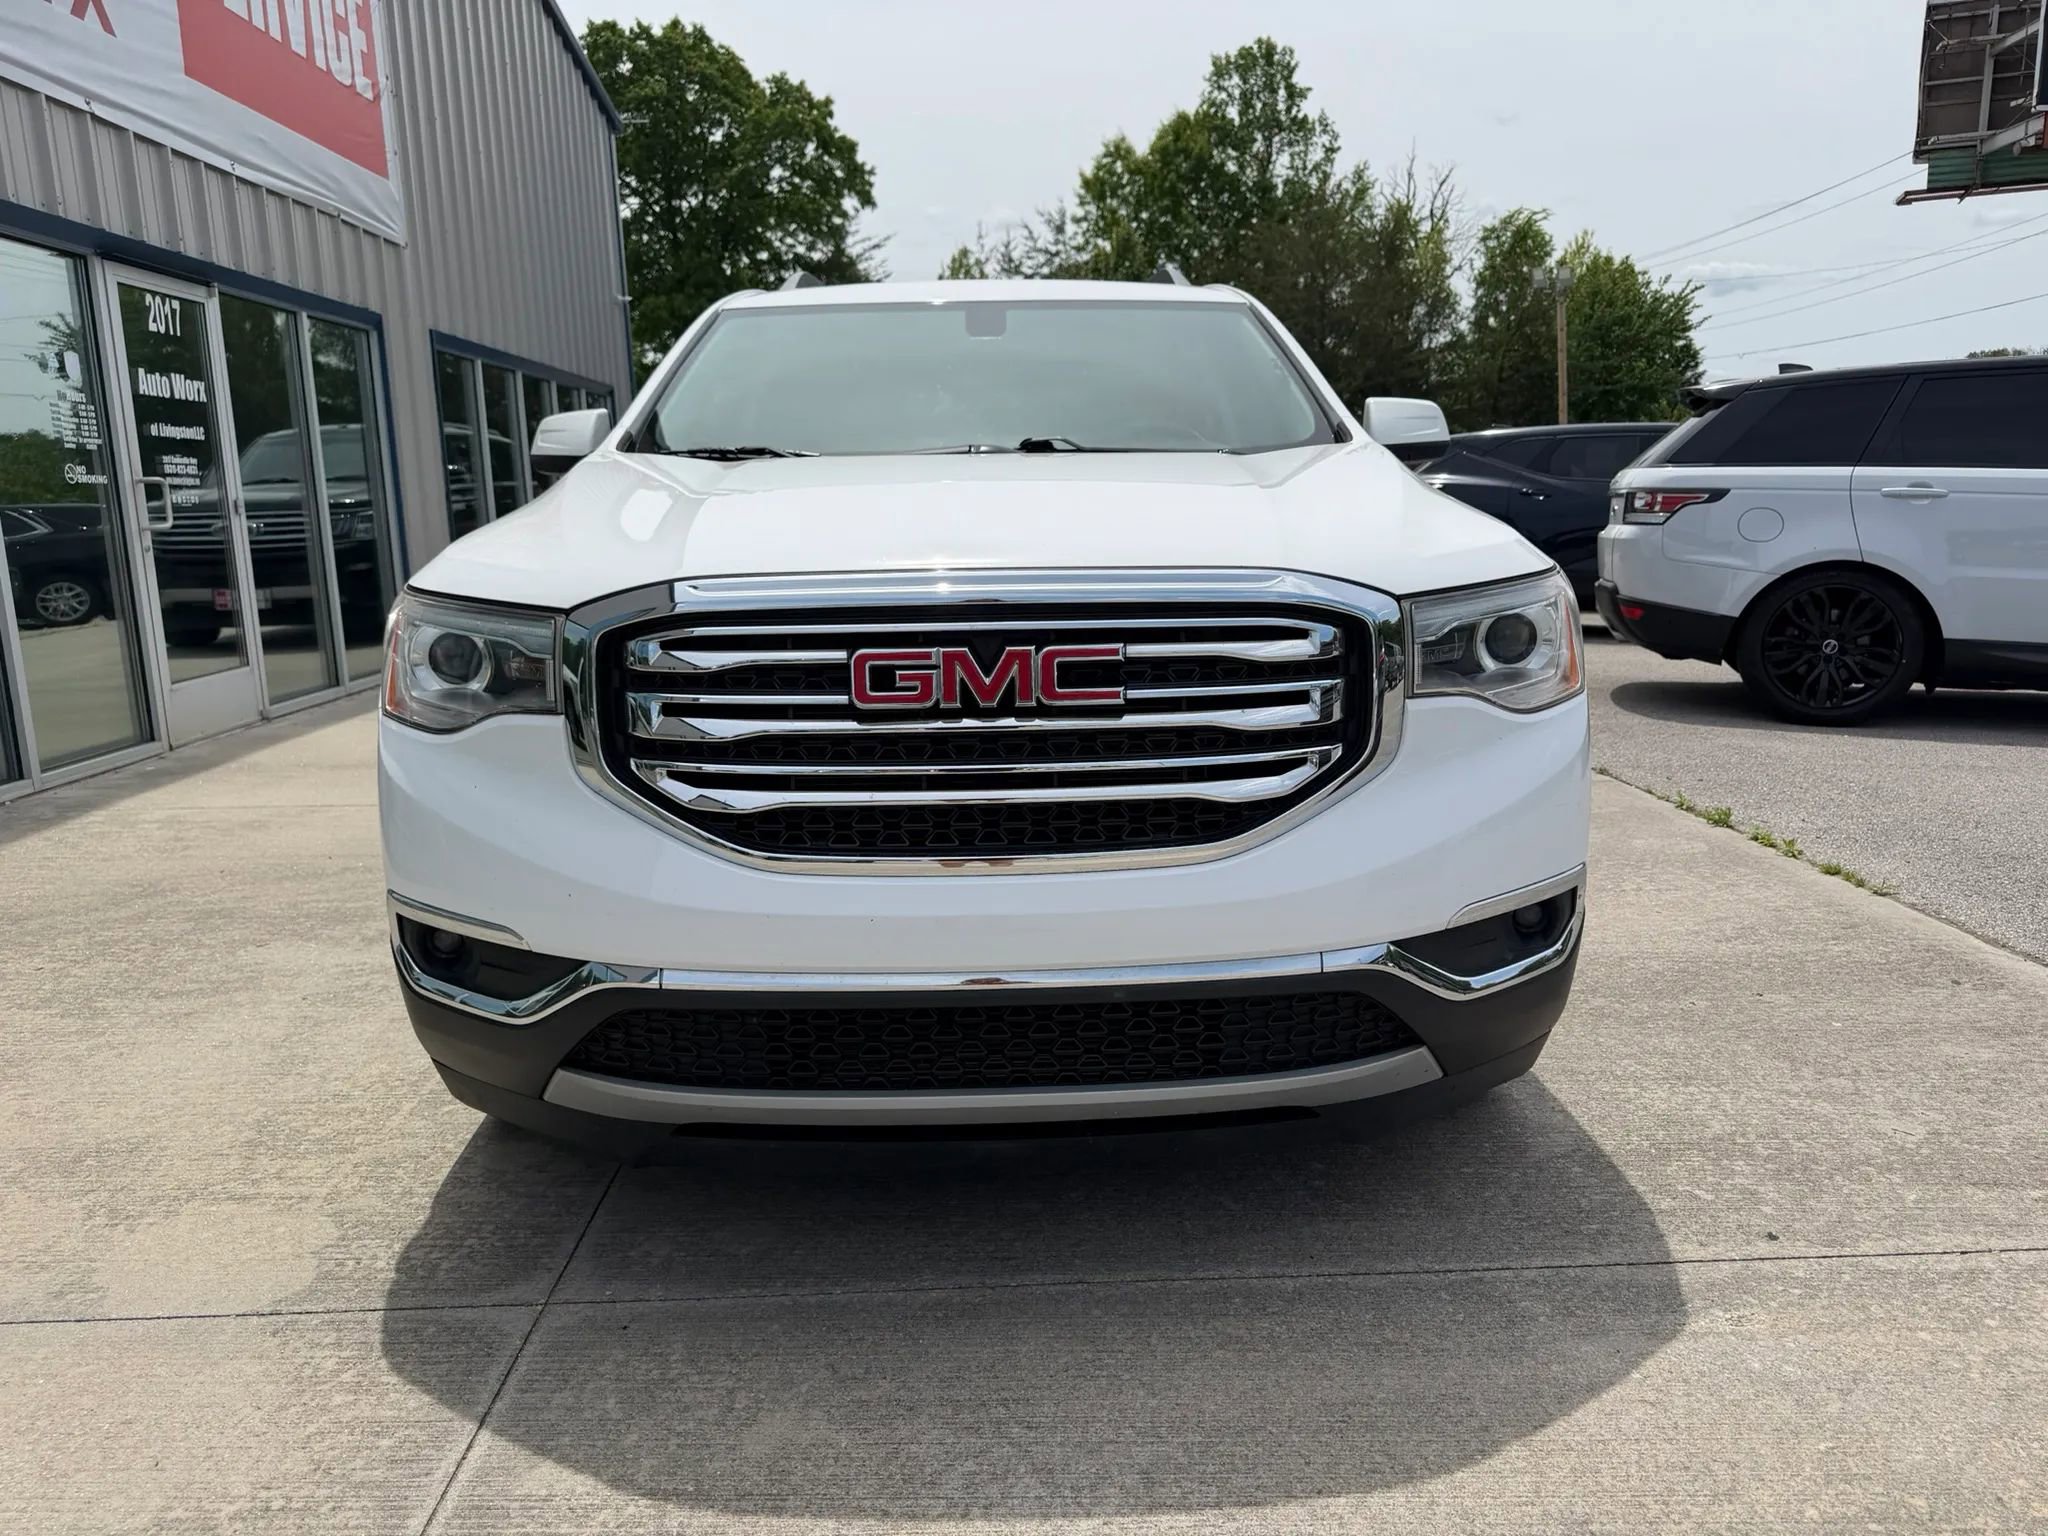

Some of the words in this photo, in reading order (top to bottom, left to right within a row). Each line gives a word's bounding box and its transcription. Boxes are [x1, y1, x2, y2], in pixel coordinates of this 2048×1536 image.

[145, 293, 180, 336] 2017
[138, 367, 170, 398] Auto
[170, 372, 207, 402] Worx
[76, 465, 87, 474] NO
[77, 474, 108, 484] SMOKING
[851, 645, 1125, 710] GMC
